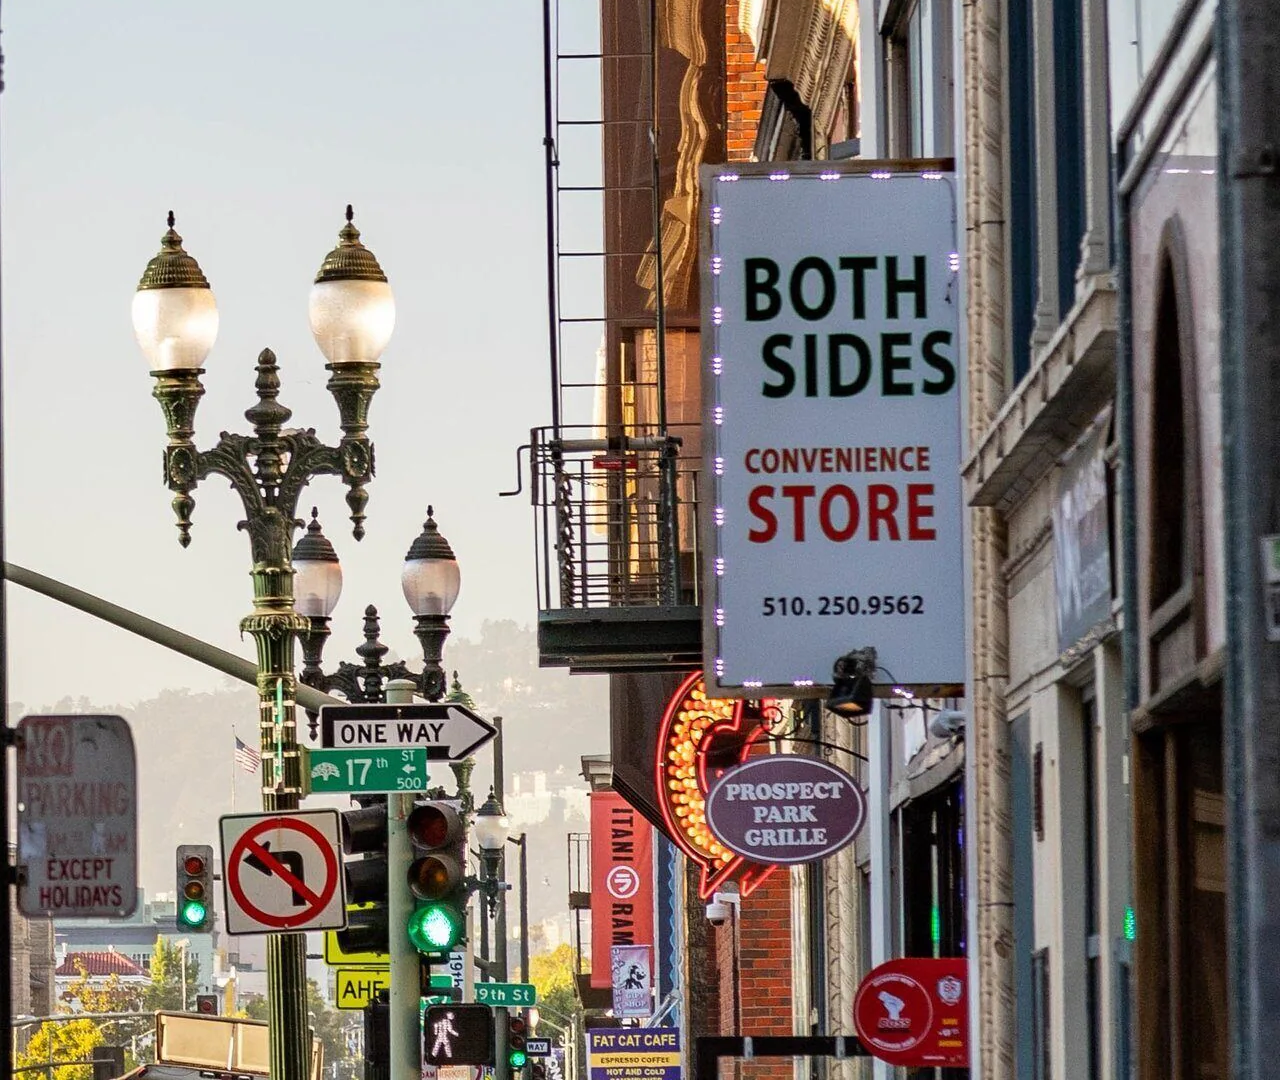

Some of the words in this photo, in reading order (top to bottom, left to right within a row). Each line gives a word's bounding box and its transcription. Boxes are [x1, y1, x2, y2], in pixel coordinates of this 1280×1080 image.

[744, 255, 928, 322] BOTH
[761, 331, 956, 399] SIDES
[745, 446, 930, 474] CONVENIENCE
[747, 484, 937, 544] STORE
[341, 724, 387, 744] ONE
[397, 723, 444, 743] WAY
[26, 725, 68, 766] NO
[402, 751, 415, 761] ST
[397, 778, 421, 790] 500
[725, 782, 843, 801] PROSPECT
[28, 782, 129, 817] PARKING
[752, 805, 818, 823] PARK
[612, 808, 633, 861] ITANI
[744, 828, 828, 846] GRILLE
[47, 859, 114, 881] EXCEPT
[40, 886, 123, 908] HOLIDAYS
[612, 903, 633, 945] RAM
[342, 981, 384, 999] AHE
[513, 989, 530, 1001] St
[528, 1043, 546, 1051] WAY
[593, 1035, 616, 1047] FAT
[618, 1035, 642, 1047] CAT
[644, 1034, 676, 1046] CAFE
[606, 1068, 624, 1076] HOT
[625, 1068, 642, 1076] AND
[644, 1068, 666, 1076] COLD
